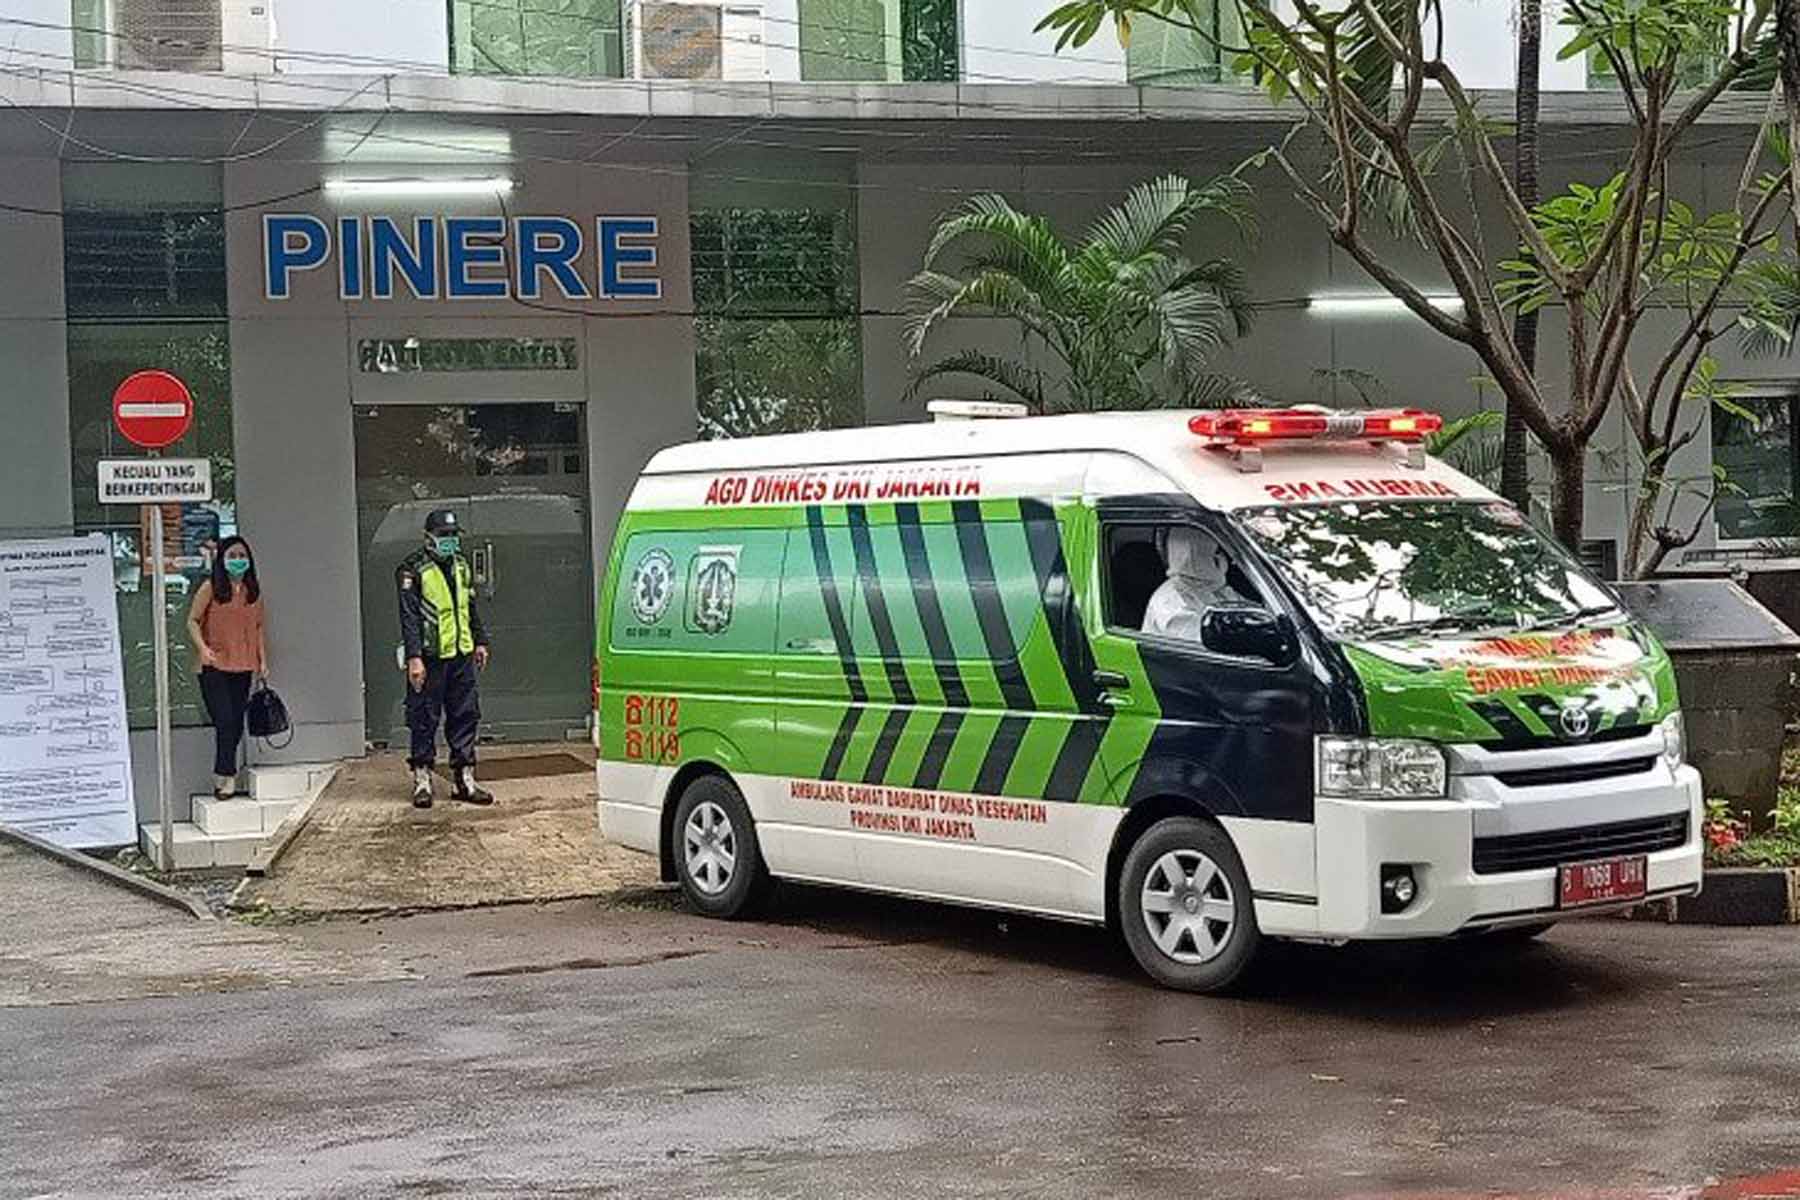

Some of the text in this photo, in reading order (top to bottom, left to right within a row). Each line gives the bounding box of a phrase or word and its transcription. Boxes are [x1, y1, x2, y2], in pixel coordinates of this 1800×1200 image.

[263, 214, 662, 299] PINERE
[113, 464, 196, 479] KECUALI YANG
[704, 466, 982, 505] AGD DINKES DKI JAKARTA
[105, 481, 206, 497] BERKEPENTINGAN
[645, 695, 679, 728] 112
[791, 781, 1047, 823] AMBULANS GAWAT DARURAT DINAS KESEHATAN
[849, 809, 901, 833] PROVINSI
[924, 818, 977, 841] JAKARTA
